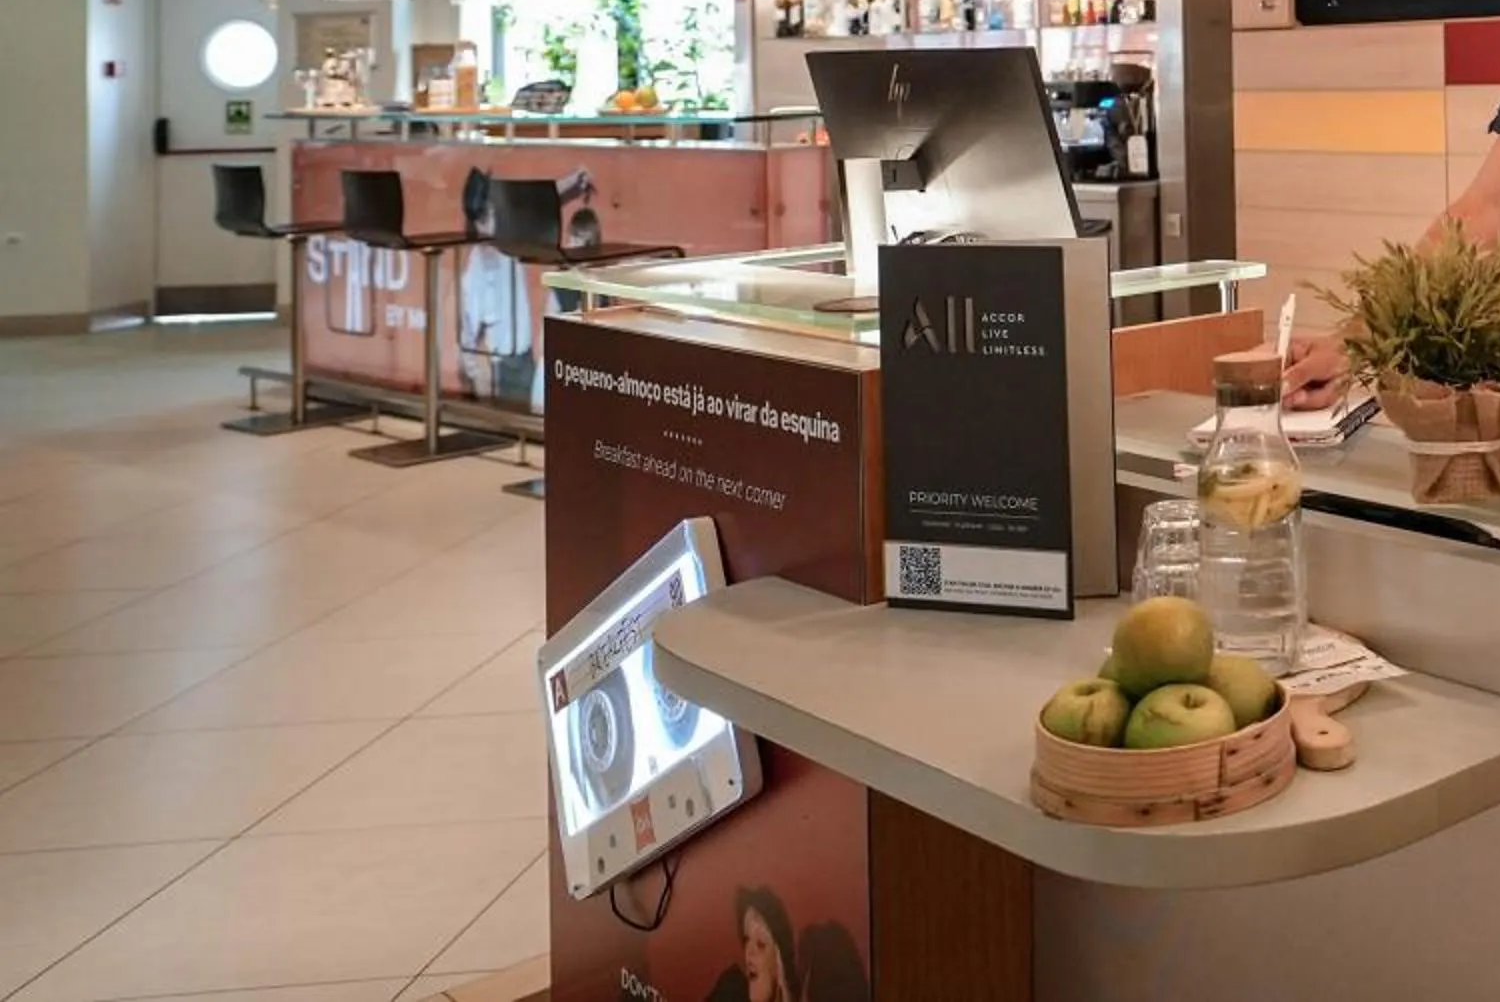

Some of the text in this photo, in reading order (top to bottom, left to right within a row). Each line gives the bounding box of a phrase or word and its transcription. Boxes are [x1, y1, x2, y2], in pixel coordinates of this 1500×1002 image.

[888, 63, 911, 119] hp
[981, 313, 1025, 324] ACCOR
[982, 329, 1009, 340] LIVE
[983, 345, 1045, 357] LIMITLESS
[555, 359, 841, 444] O pequeno-almoço está já ao virar da esquina
[594, 439, 787, 510] Breakfast ahead on the next corner
[908, 491, 1040, 511] PRIORITY WELCOME
